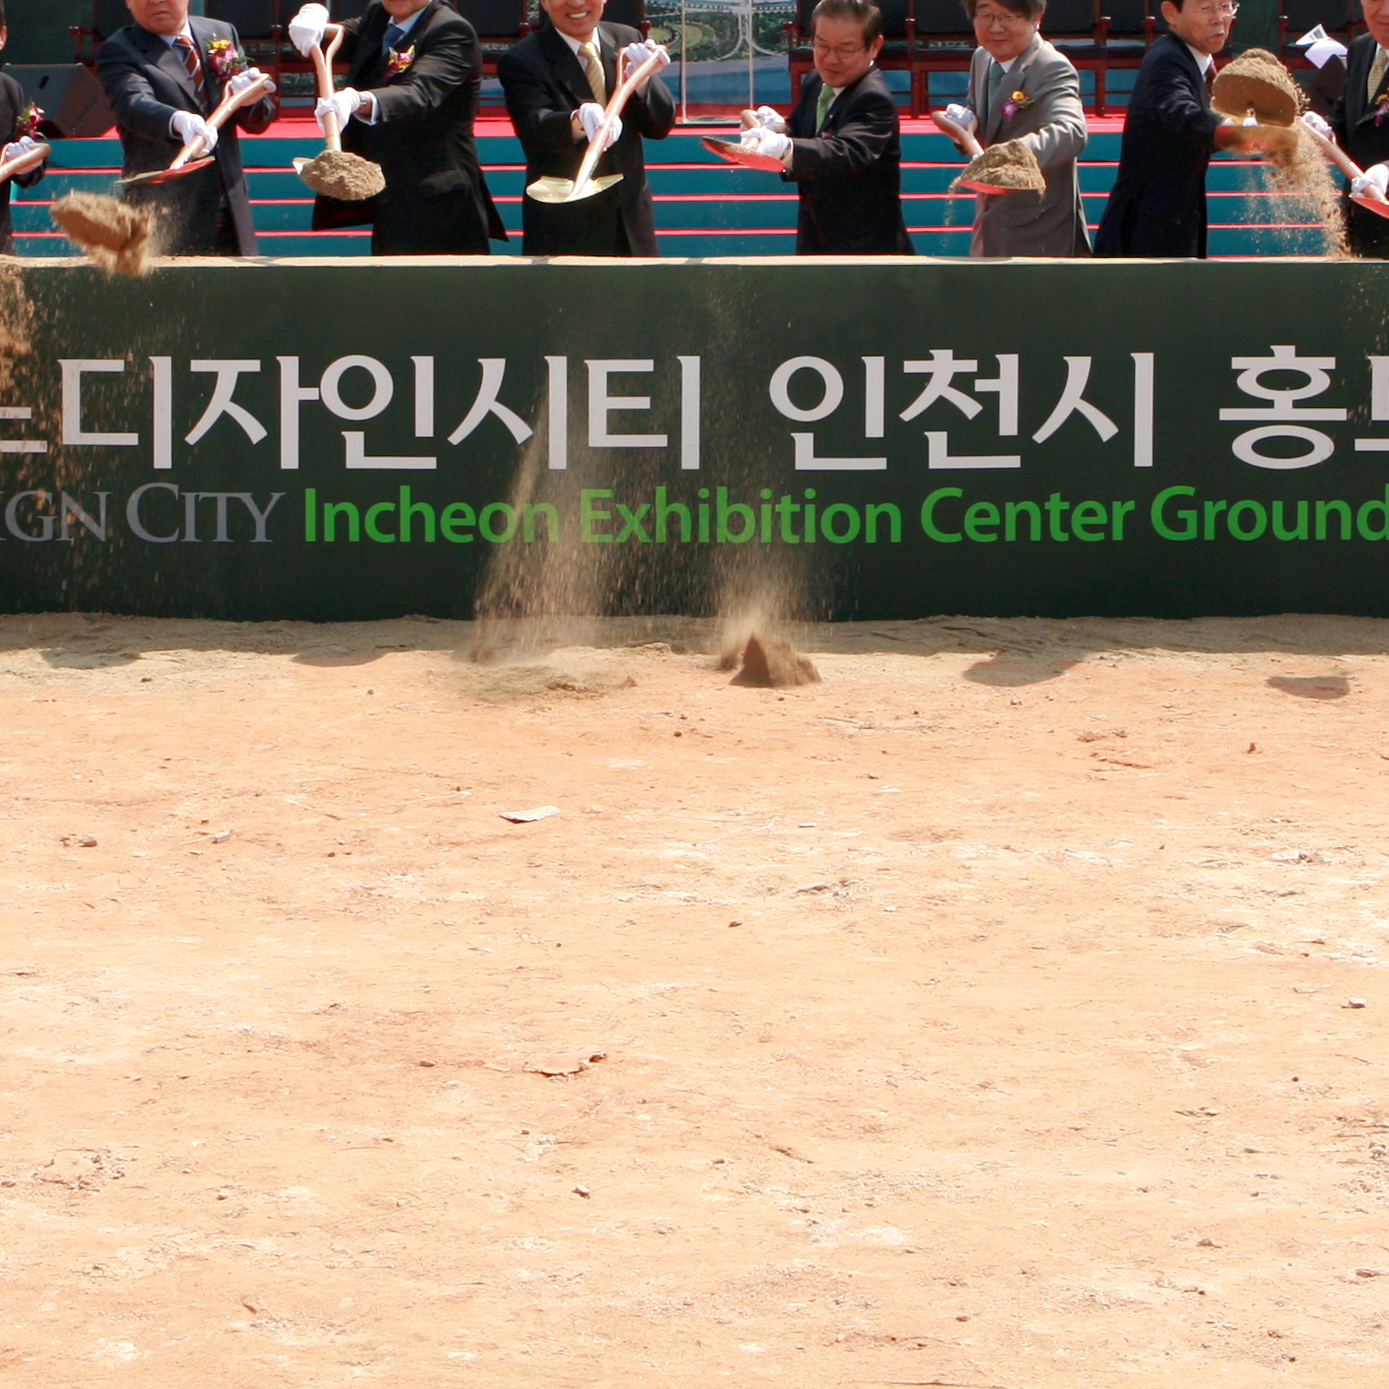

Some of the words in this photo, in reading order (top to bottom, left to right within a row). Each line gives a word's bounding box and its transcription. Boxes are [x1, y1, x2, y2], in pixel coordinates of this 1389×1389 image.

[768, 349, 1155, 471] 인천시
[125, 481, 288, 543] CITY
[304, 486, 560, 545] Incheon
[580, 487, 902, 545] Exhibition
[920, 486, 1134, 543] Center
